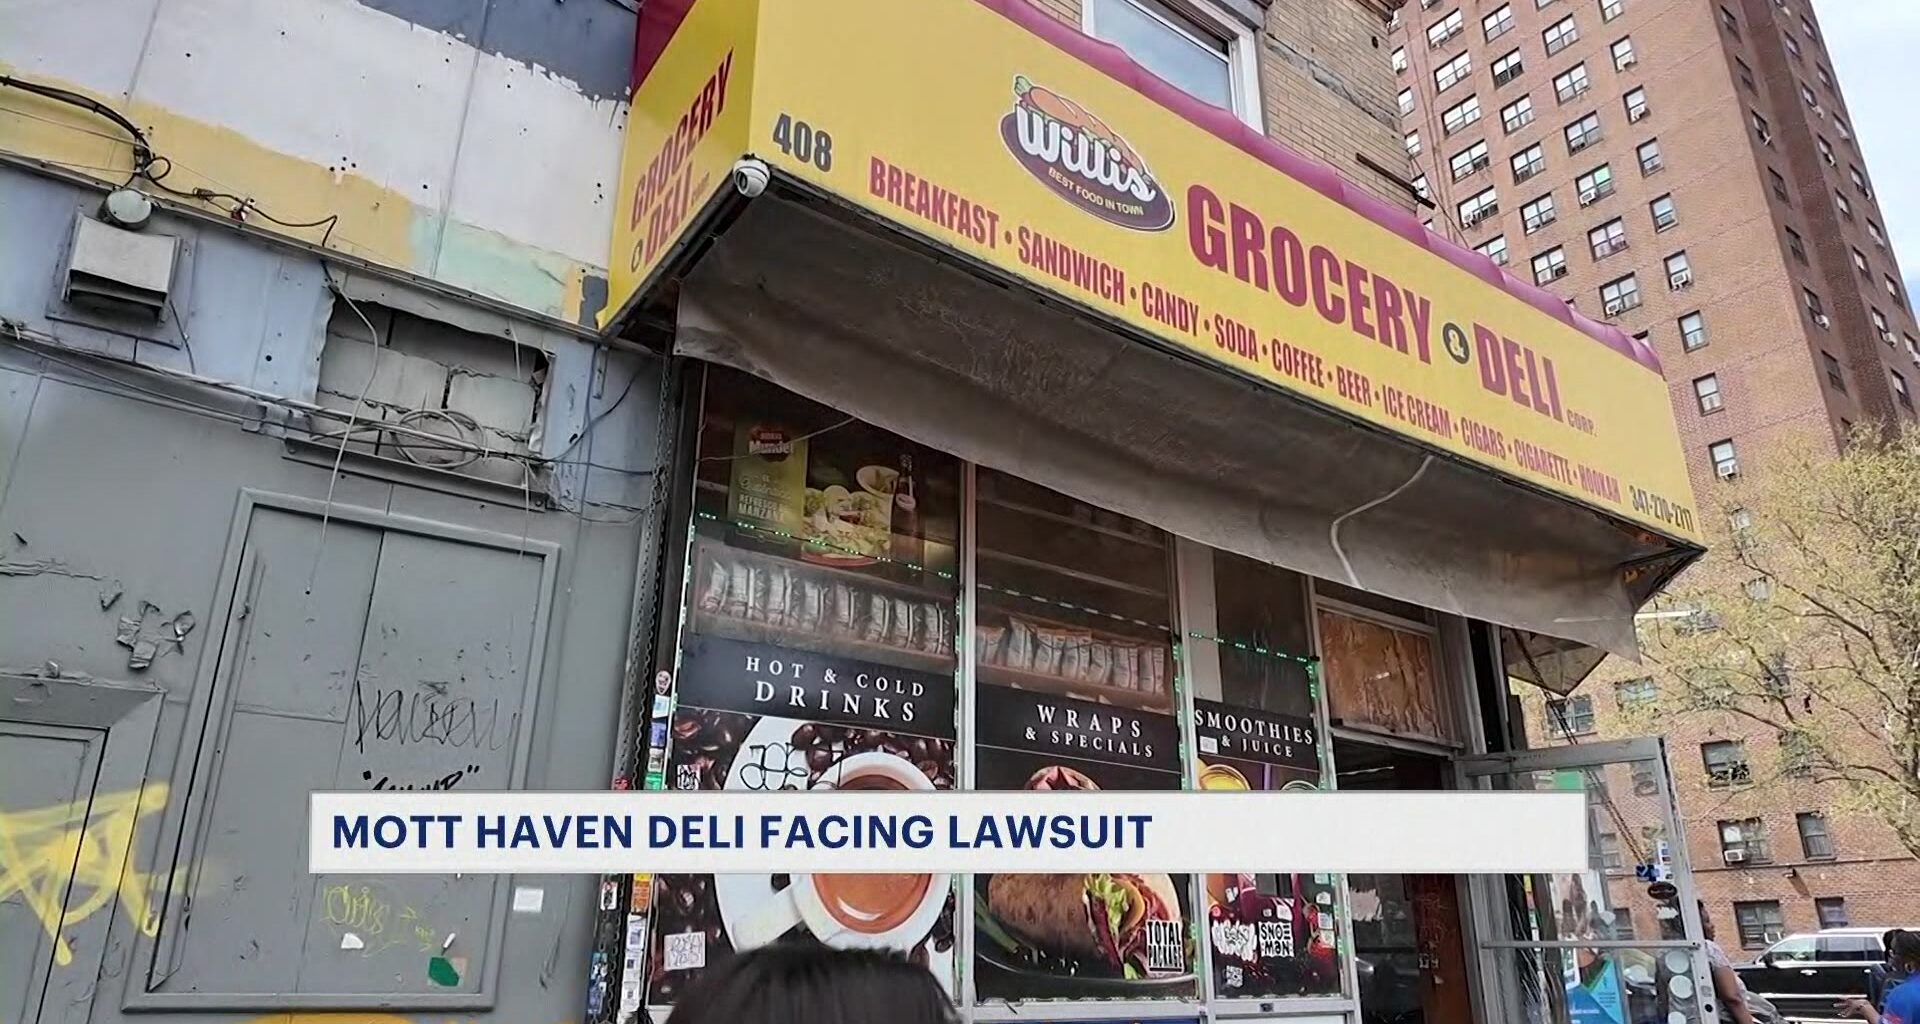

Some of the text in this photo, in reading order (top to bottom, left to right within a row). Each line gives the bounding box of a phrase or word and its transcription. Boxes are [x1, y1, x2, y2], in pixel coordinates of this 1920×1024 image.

[631, 48, 733, 231] GROCERY
[772, 111, 833, 173] 408
[1015, 103, 1156, 202] Willis
[1049, 166, 1144, 216] BEST FOOD IN TOWN
[645, 161, 693, 266] DELI
[870, 156, 1000, 249] BREAKFAST
[1018, 225, 1126, 306] SANDWICH
[1141, 281, 1199, 337] CANDY
[1214, 313, 1259, 363] SODA
[1272, 338, 1325, 389] COFFEE
[1336, 365, 1372, 407] BEER
[1382, 384, 1405, 421] ICE
[1406, 395, 1452, 440] CREAM
[1461, 416, 1506, 460] CIGARS
[1514, 438, 1573, 485] CIGARETTE
[1187, 184, 1431, 365] GROCERY
[1473, 322, 1564, 423] DELI
[746, 656, 925, 697] HOT & COLD
[755, 680, 916, 722] DRINKS
[1037, 704, 1142, 738] WRAPS
[1025, 726, 1154, 758] & SPECIALS
[1195, 708, 1313, 745] SMOOTHIES
[1221, 735, 1293, 758] & JUICE
[1148, 921, 1180, 945] TOTAL
[1149, 946, 1183, 968] PACKAGE
